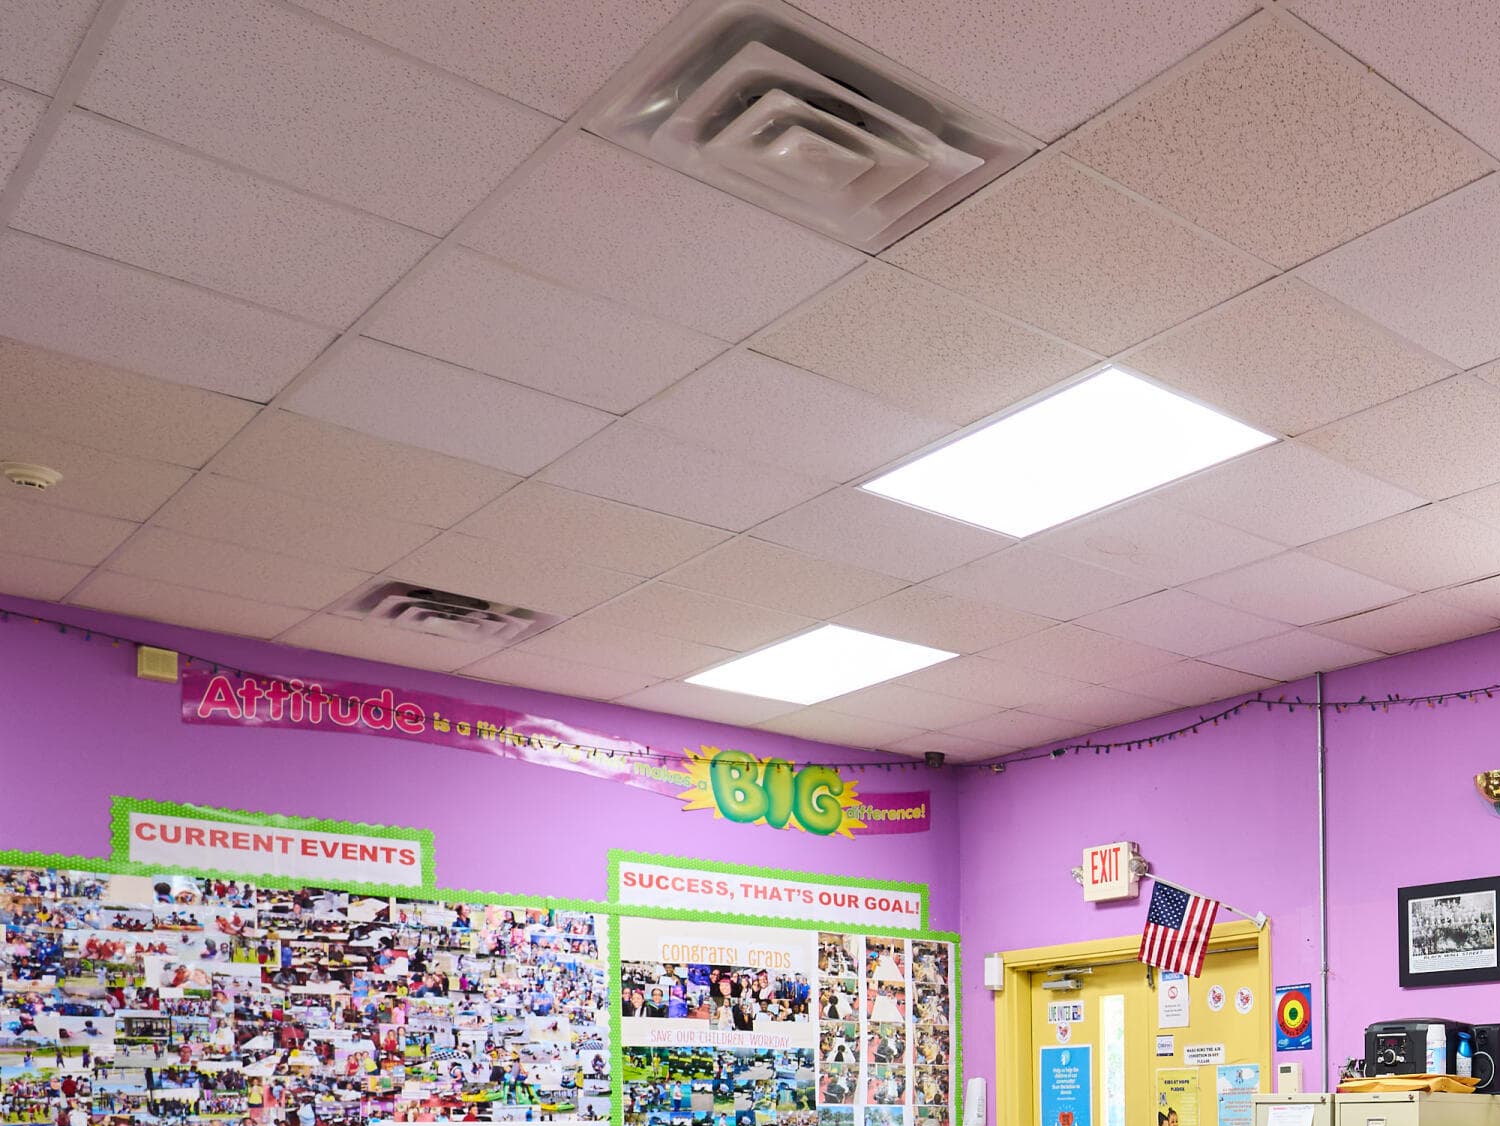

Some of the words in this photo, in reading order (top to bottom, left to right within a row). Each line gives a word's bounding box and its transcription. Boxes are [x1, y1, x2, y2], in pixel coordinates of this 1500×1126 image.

[199, 676, 425, 734] Attitude
[433, 712, 450, 732] is
[457, 721, 471, 736] a
[633, 761, 692, 787] makes
[697, 780, 707, 791] a
[710, 750, 844, 836] BIG
[846, 803, 926, 821] difference!
[135, 822, 295, 856] CURRENT
[301, 839, 416, 866] EVENTS
[1091, 846, 1121, 885] EXIT
[623, 871, 735, 899] SUCCESS,
[740, 883, 814, 904] THAT'S
[818, 891, 860, 909] OUR
[864, 896, 920, 915] GOAL!
[651, 1030, 673, 1043] SAVE
[676, 1030, 695, 1043] OUR
[699, 1031, 745, 1045] CHILDREN
[749, 1033, 790, 1049] WORKDAY
